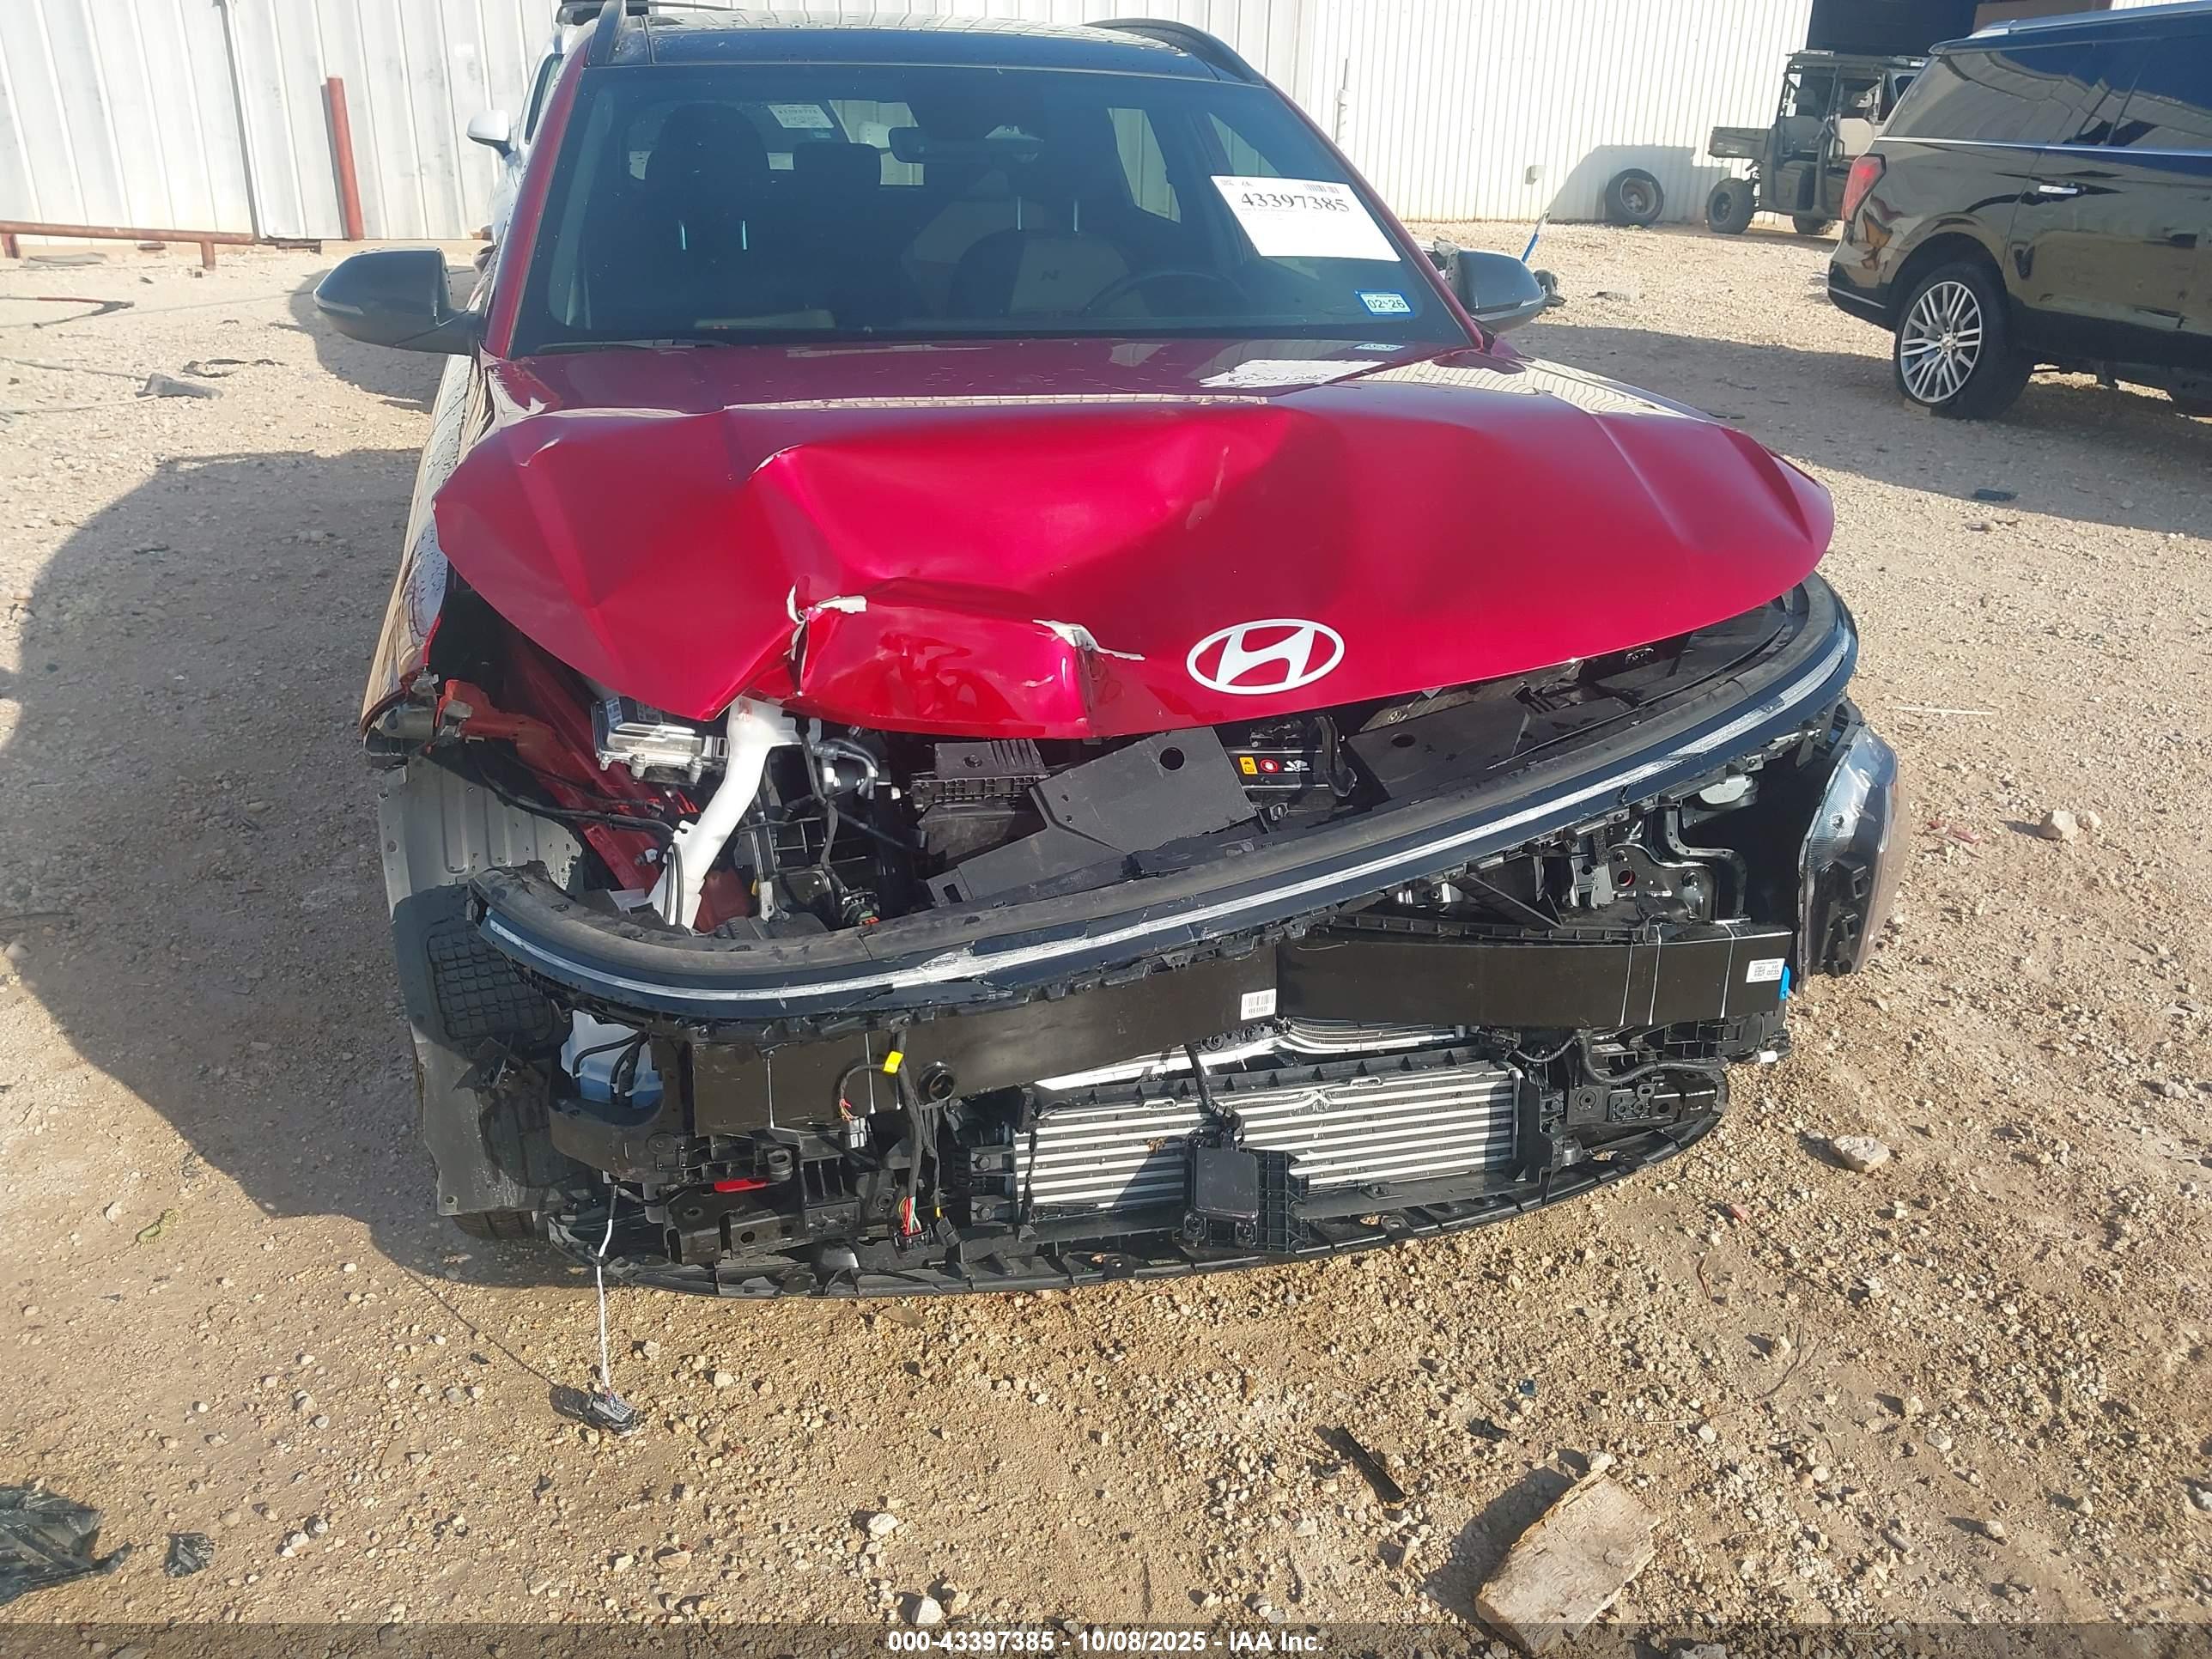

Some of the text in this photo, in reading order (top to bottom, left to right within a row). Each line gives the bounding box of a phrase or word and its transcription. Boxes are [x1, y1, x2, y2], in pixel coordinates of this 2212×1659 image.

[1240, 192, 1350, 213] 43397385
[1367, 300, 1406, 309] 02 26
